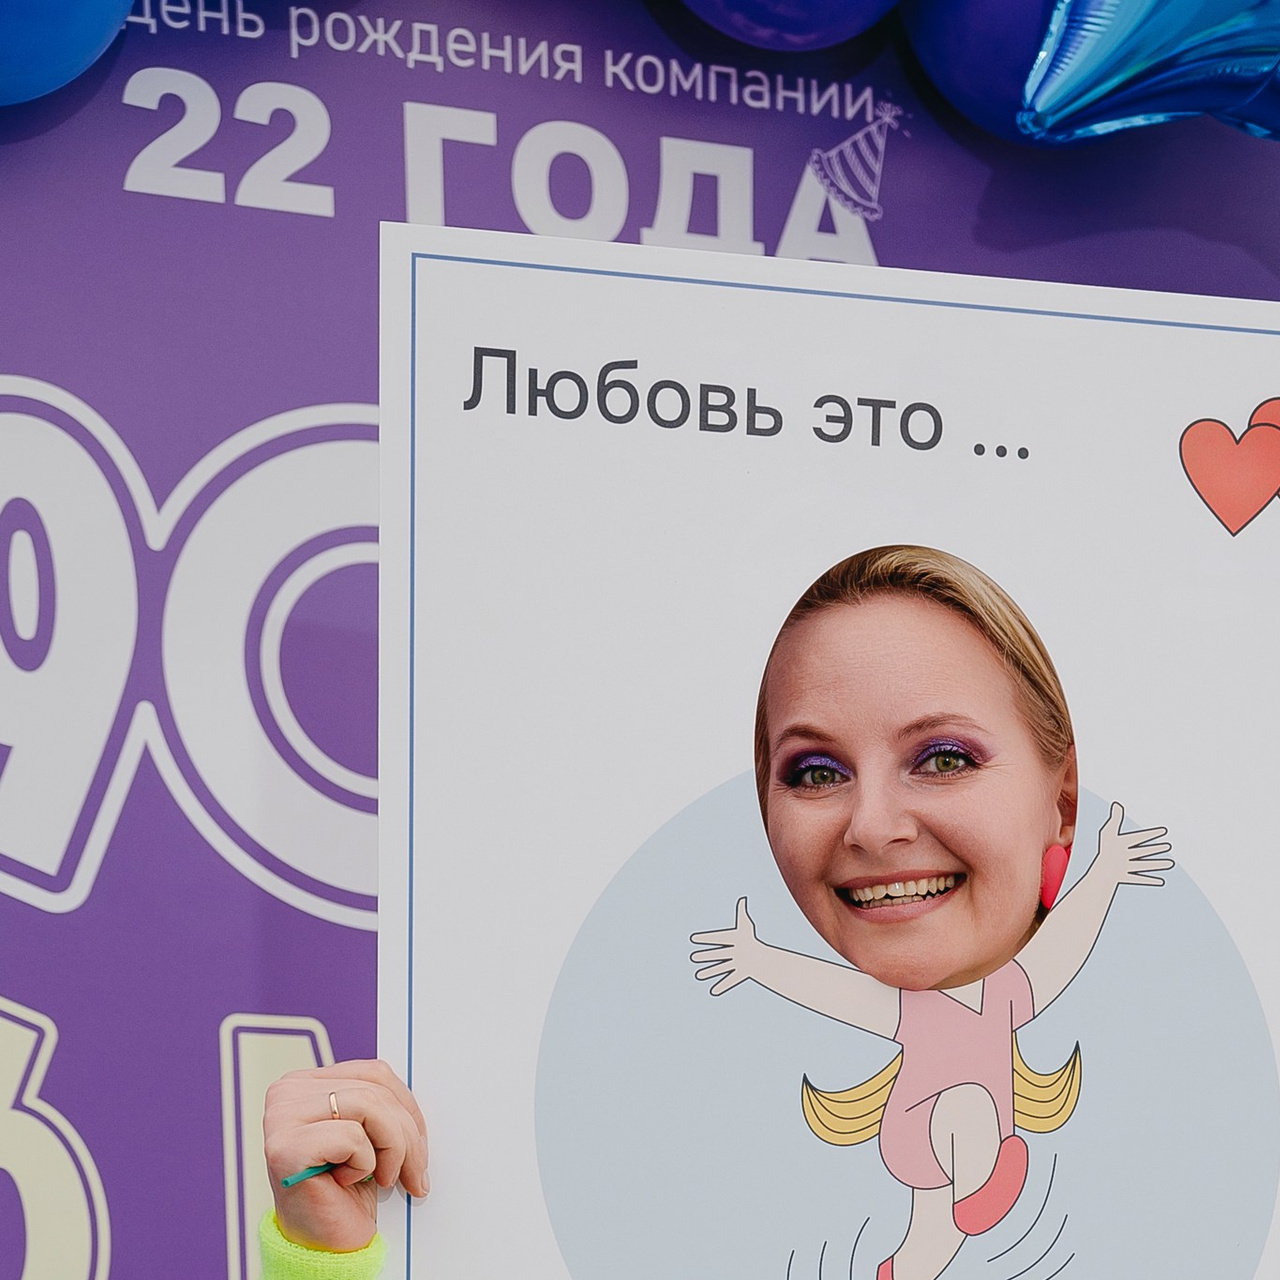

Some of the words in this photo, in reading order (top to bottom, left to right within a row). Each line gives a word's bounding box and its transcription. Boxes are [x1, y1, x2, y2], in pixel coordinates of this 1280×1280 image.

[289, 6, 583, 84] рождения
[604, 49, 873, 122] компании
[121, 66, 335, 218] 22
[403, 100, 880, 267] ГОДА
[463, 346, 784, 437] Любовь
[812, 394, 943, 451] это
